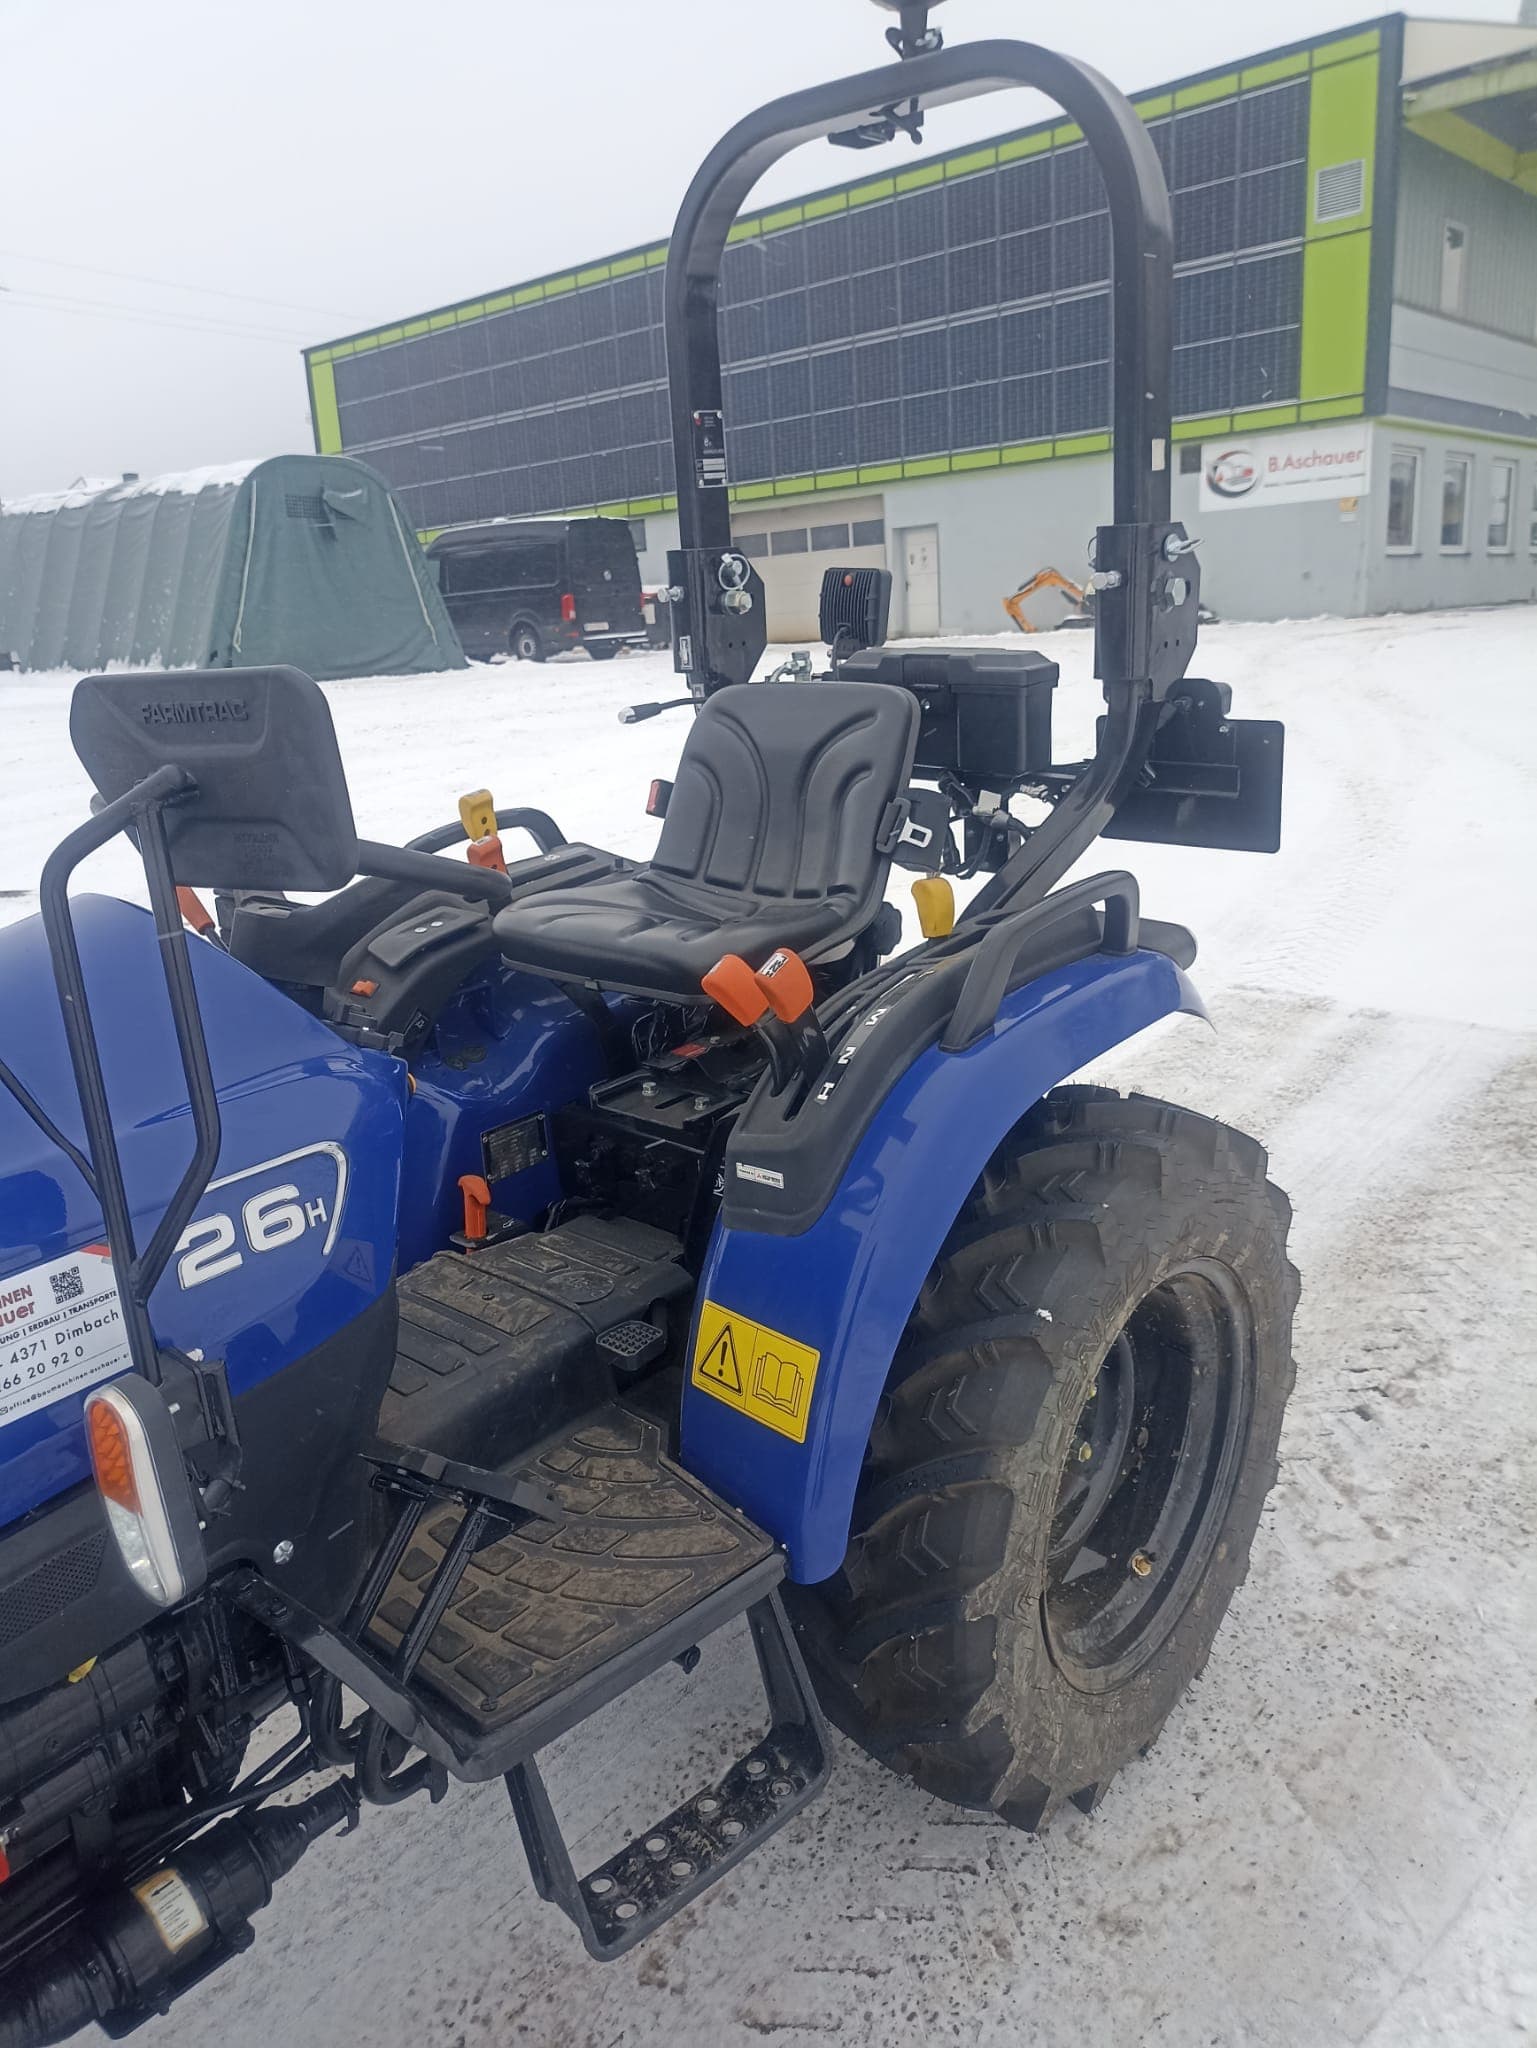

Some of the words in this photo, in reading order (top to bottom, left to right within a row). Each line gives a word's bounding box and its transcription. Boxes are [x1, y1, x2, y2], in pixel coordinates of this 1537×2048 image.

[142, 701, 249, 724] FARMTRAC
[10, 1339, 47, 1364] 4371
[55, 1309, 119, 1345] Dimbach
[28, 1314, 61, 1332] ERDBAU
[0, 1373, 21, 1392] 66
[27, 1362, 46, 1379] 20
[51, 1352, 69, 1368] 92
[75, 1345, 84, 1357] 0
